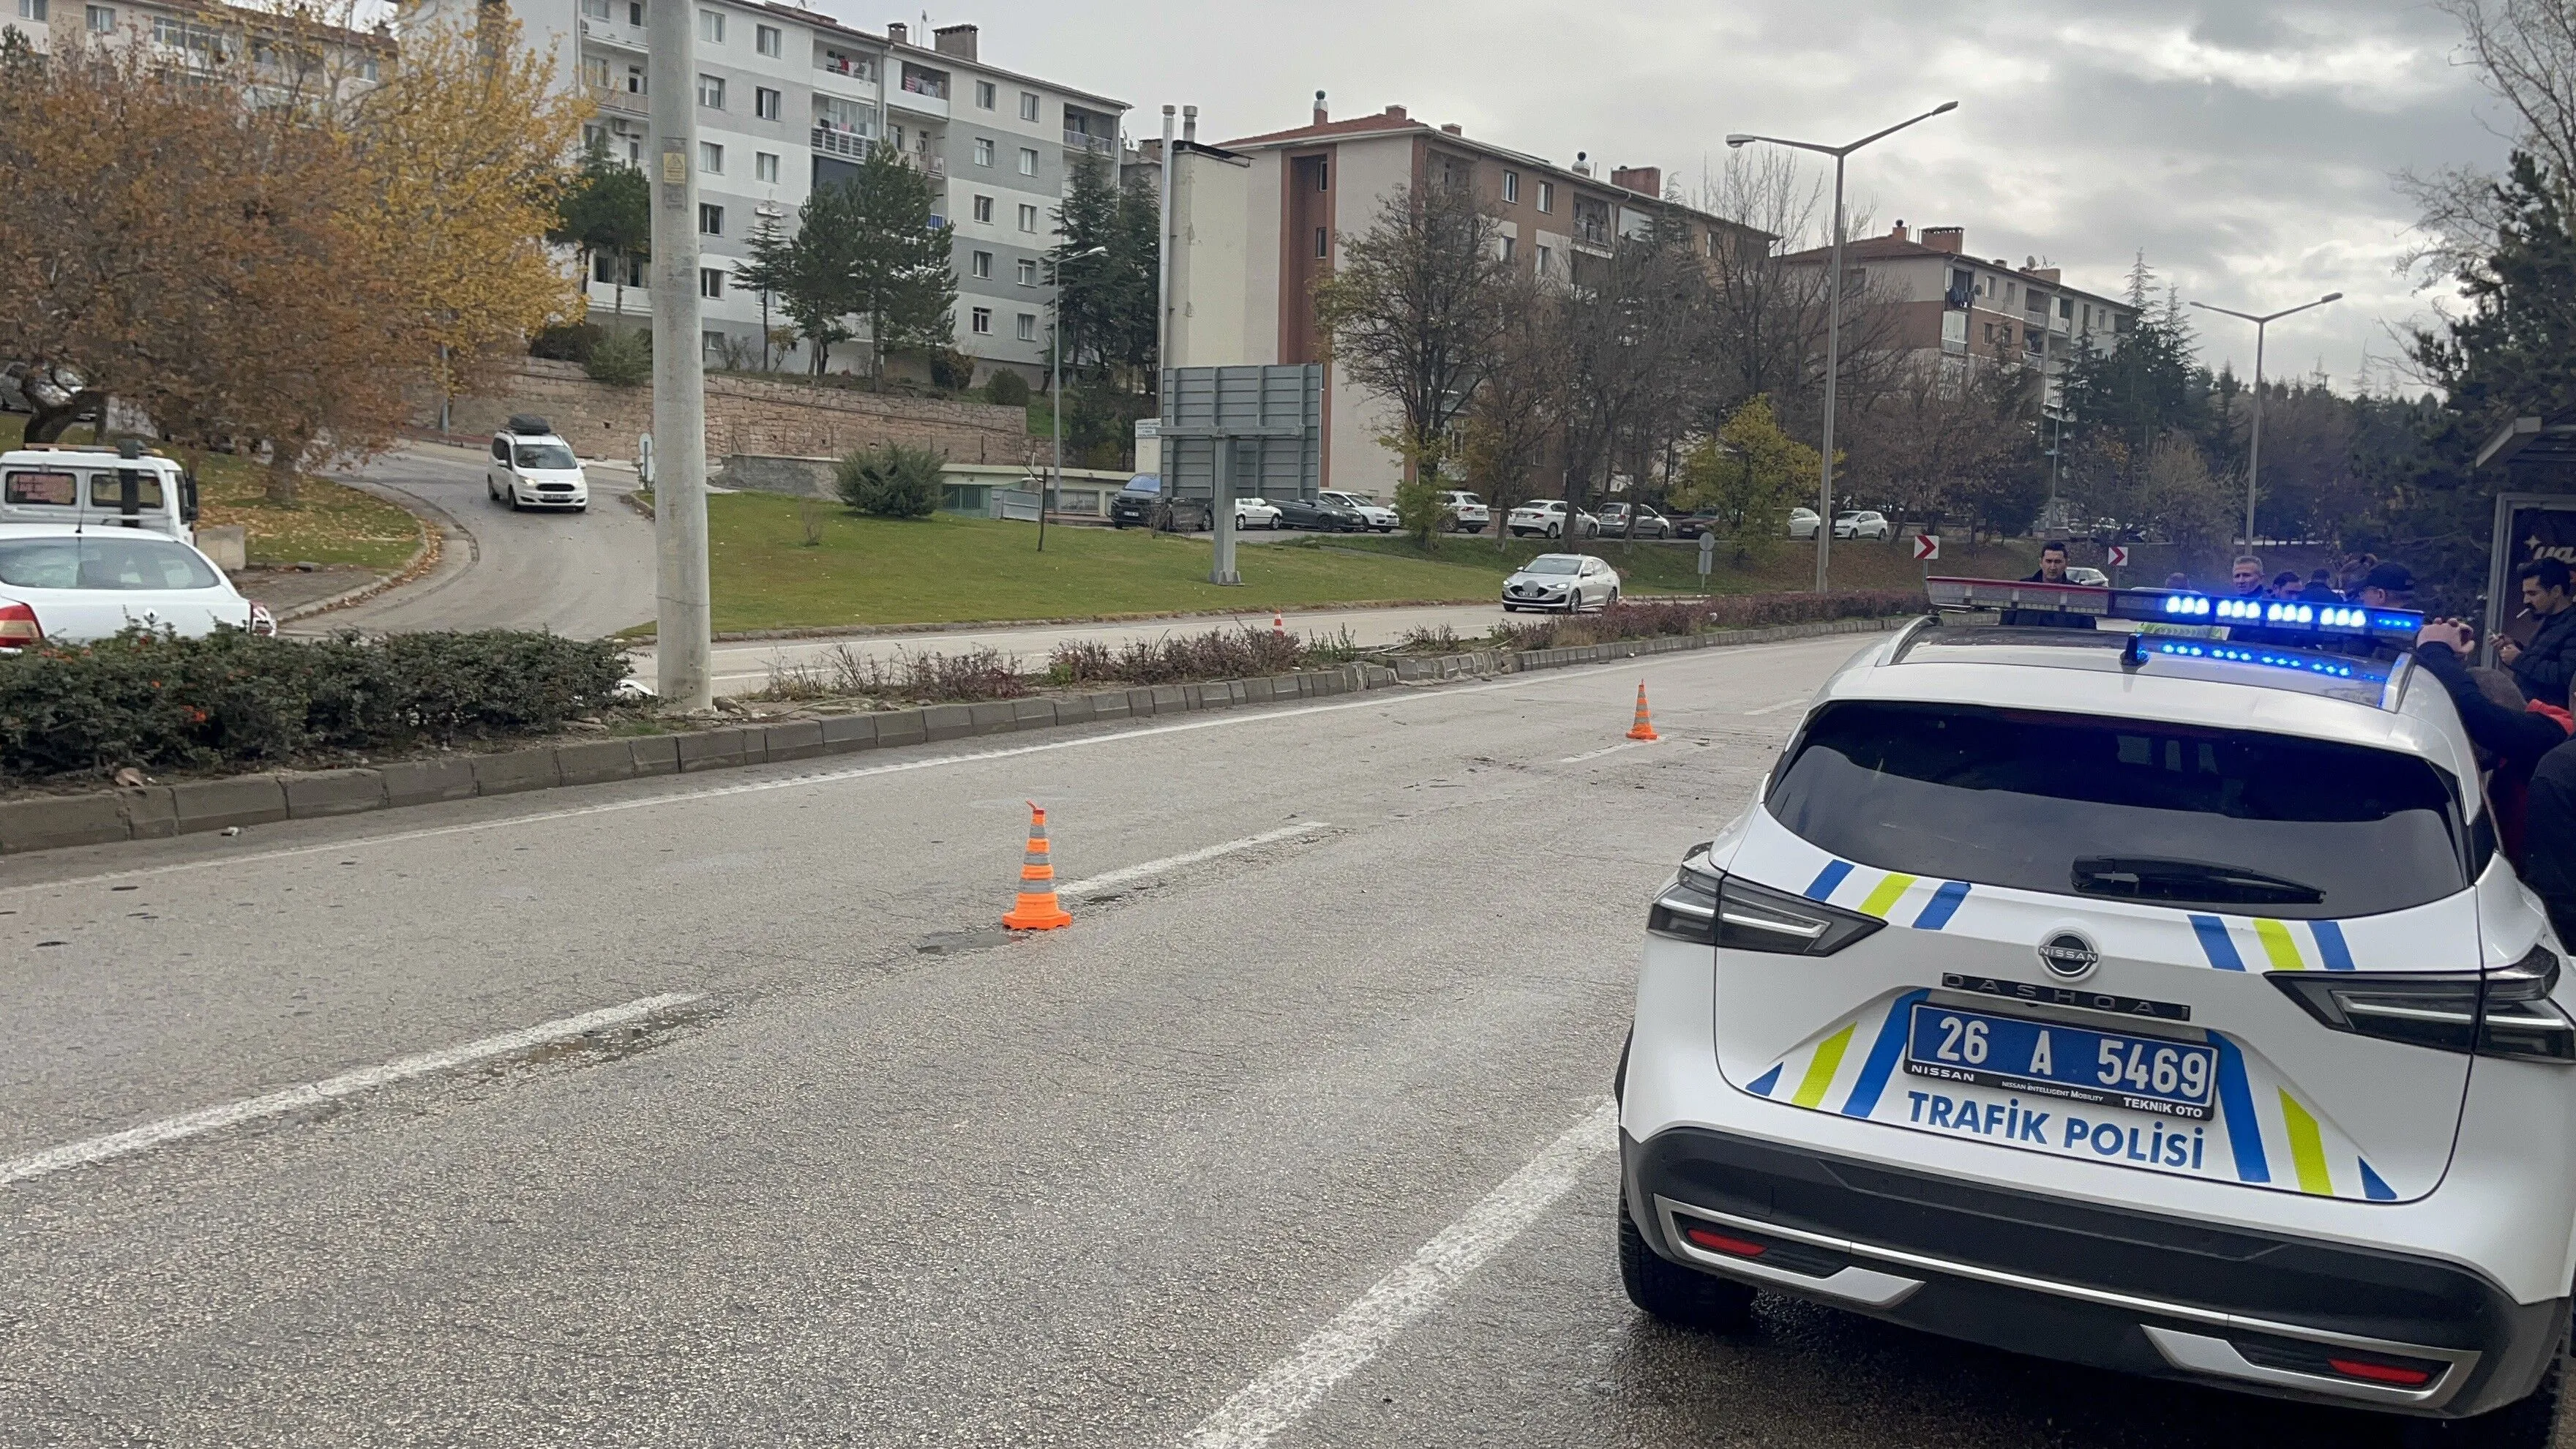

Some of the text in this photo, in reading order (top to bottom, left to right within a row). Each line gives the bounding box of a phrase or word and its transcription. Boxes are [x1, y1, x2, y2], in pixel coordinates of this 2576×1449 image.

[2040, 947, 2097, 962] NISSAN
[1936, 1016, 2208, 1098] 26 A 5469
[1912, 1064, 1974, 1082] NISSAN
[2002, 1081, 2026, 1090] NISSAN
[2070, 1090, 2104, 1103] MOBILITY
[2176, 1105, 2204, 1118] OTO
[1908, 1090, 2204, 1170] TRAFİK POLİSİ
